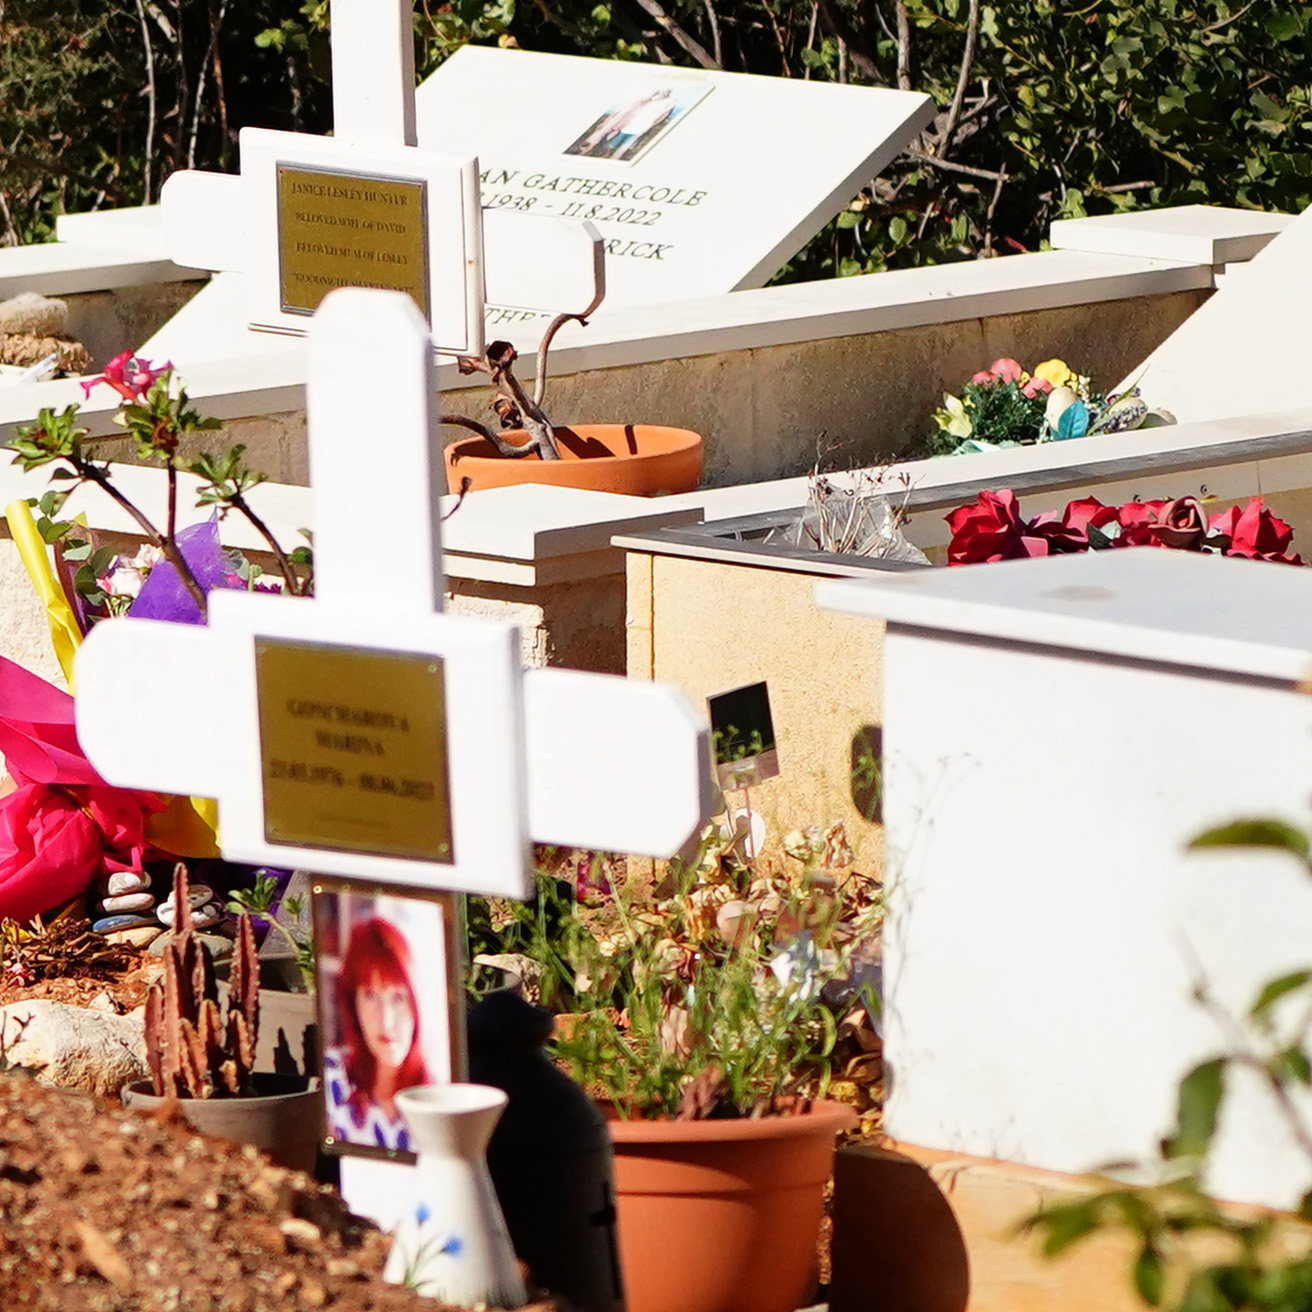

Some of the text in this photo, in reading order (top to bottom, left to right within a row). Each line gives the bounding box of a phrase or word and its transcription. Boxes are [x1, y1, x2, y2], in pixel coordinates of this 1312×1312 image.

[292, 181, 326, 197] JANICE
[327, 186, 364, 201] LESLEY
[479, 167, 708, 207] AN GATHERCOLE
[559, 200, 663, 227] 11.8.2022
[376, 220, 407, 234] DAVID
[602, 237, 674, 261] RICK
